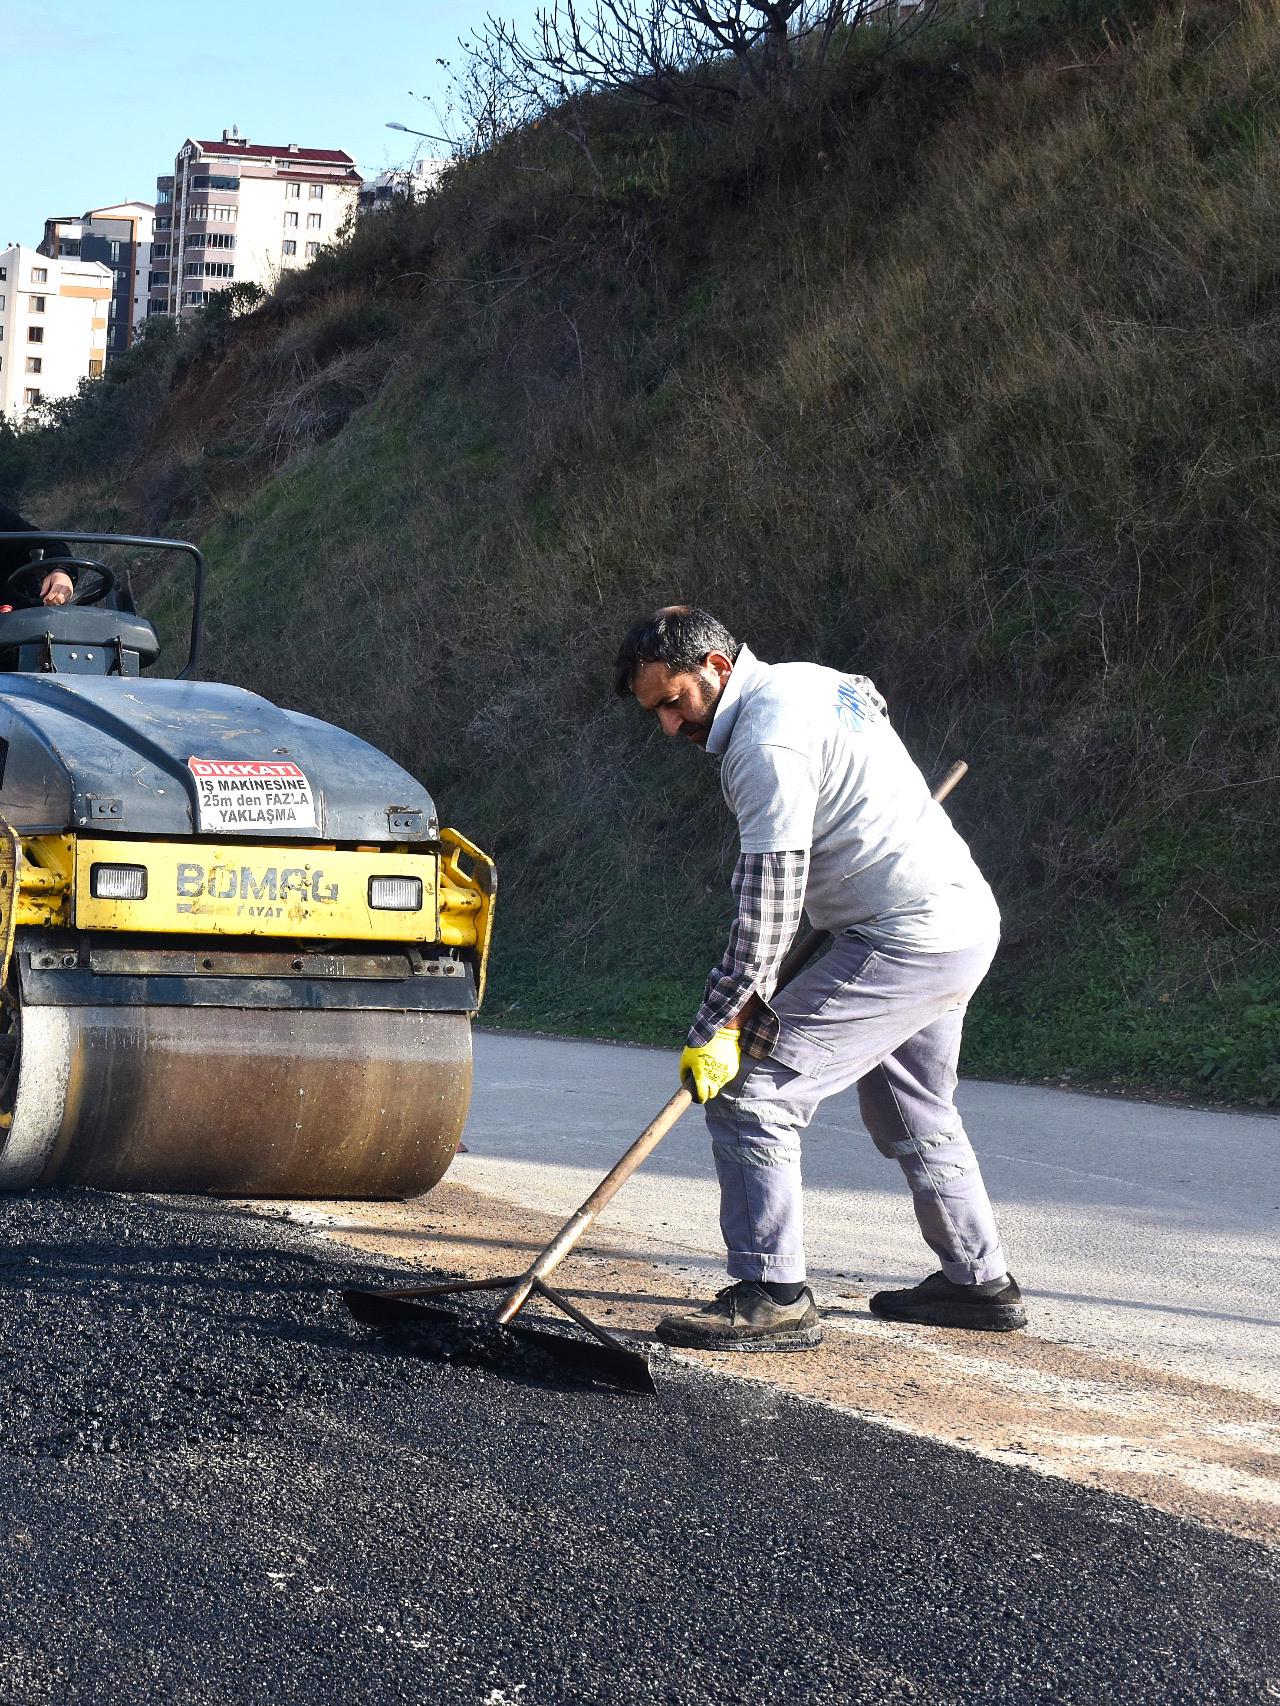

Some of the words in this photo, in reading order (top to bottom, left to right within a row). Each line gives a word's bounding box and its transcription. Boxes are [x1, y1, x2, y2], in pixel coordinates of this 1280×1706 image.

[200, 778, 214, 794] İŞ
[218, 778, 307, 792] MAKİNESİNE
[203, 794, 233, 807] 25m
[236, 794, 262, 807] den
[265, 793, 309, 806] FAZLA
[219, 808, 297, 825] YAKLAŞMA
[177, 863, 339, 902] BOMAG
